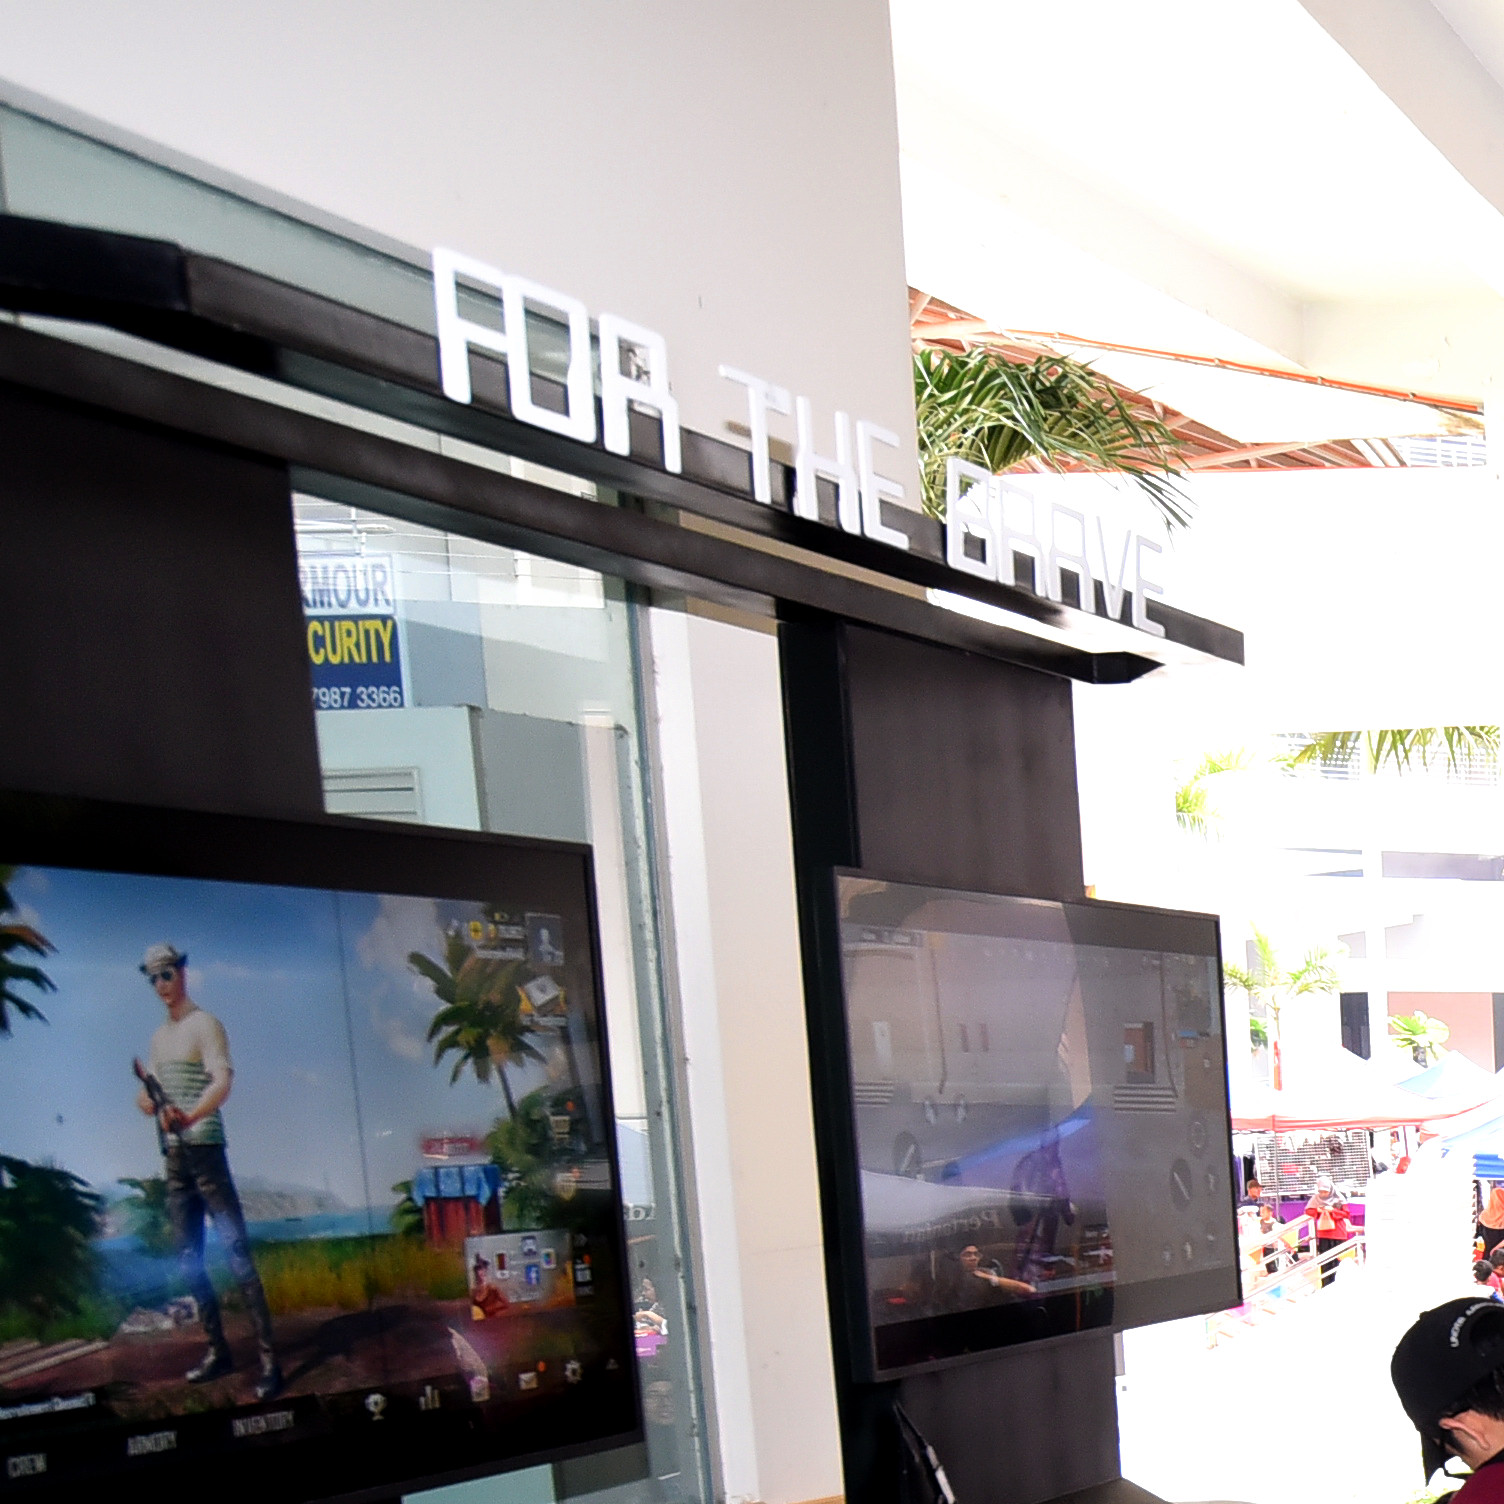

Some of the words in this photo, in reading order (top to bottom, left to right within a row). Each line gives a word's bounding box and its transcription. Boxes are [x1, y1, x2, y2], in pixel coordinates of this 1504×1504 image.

[433, 246, 682, 473] FOR
[719, 364, 909, 550] THE
[946, 456, 1166, 638] BRAVE
[307, 619, 393, 665] CURITY
[356, 686, 401, 708] 3366
